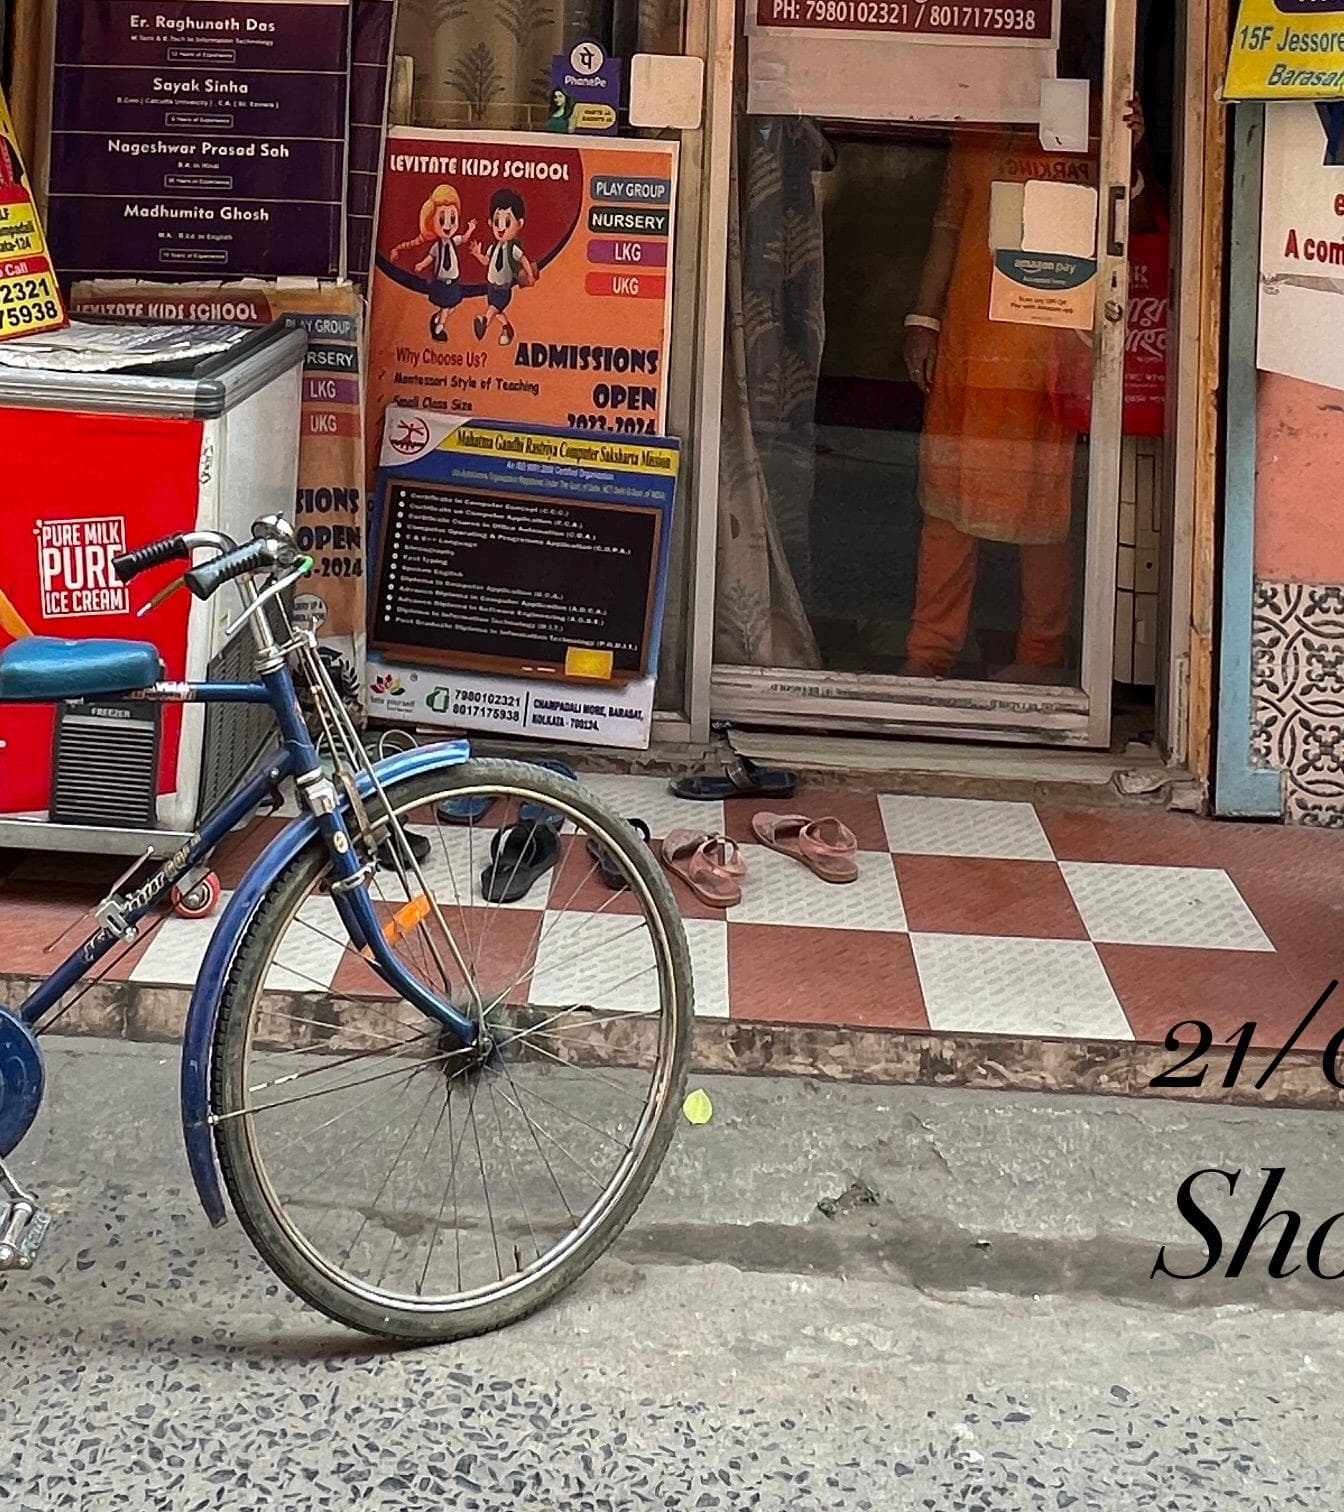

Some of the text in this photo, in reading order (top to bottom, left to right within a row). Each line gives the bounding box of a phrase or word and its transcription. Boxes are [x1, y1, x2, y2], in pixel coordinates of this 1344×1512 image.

[130, 15, 276, 32] Er. Raghunath Das
[805, 0, 908, 25] 7980102321
[929, 5, 1037, 31] 8017175938
[1239, 25, 1273, 52] 15F
[153, 77, 249, 94] Sayak Sinha
[108, 139, 290, 158] Nageshwar Prasad Sah
[390, 154, 570, 181] LEVITATE KIDS SCHOOL
[596, 180, 666, 199] PLAY GROUP
[124, 204, 270, 222] Madhumita Ghosh
[592, 213, 666, 230] NURSERY
[614, 245, 642, 262] LKG
[1284, 230, 1300, 260] A
[612, 277, 640, 296] UKG
[514, 342, 660, 375] ADMISSIONS
[592, 383, 658, 411] OPEN
[43, 520, 120, 547] PURE MILK
[43, 544, 125, 590] PURE
[45, 588, 124, 614] ICE CREAM
[90, 707, 132, 719] FREEZER
